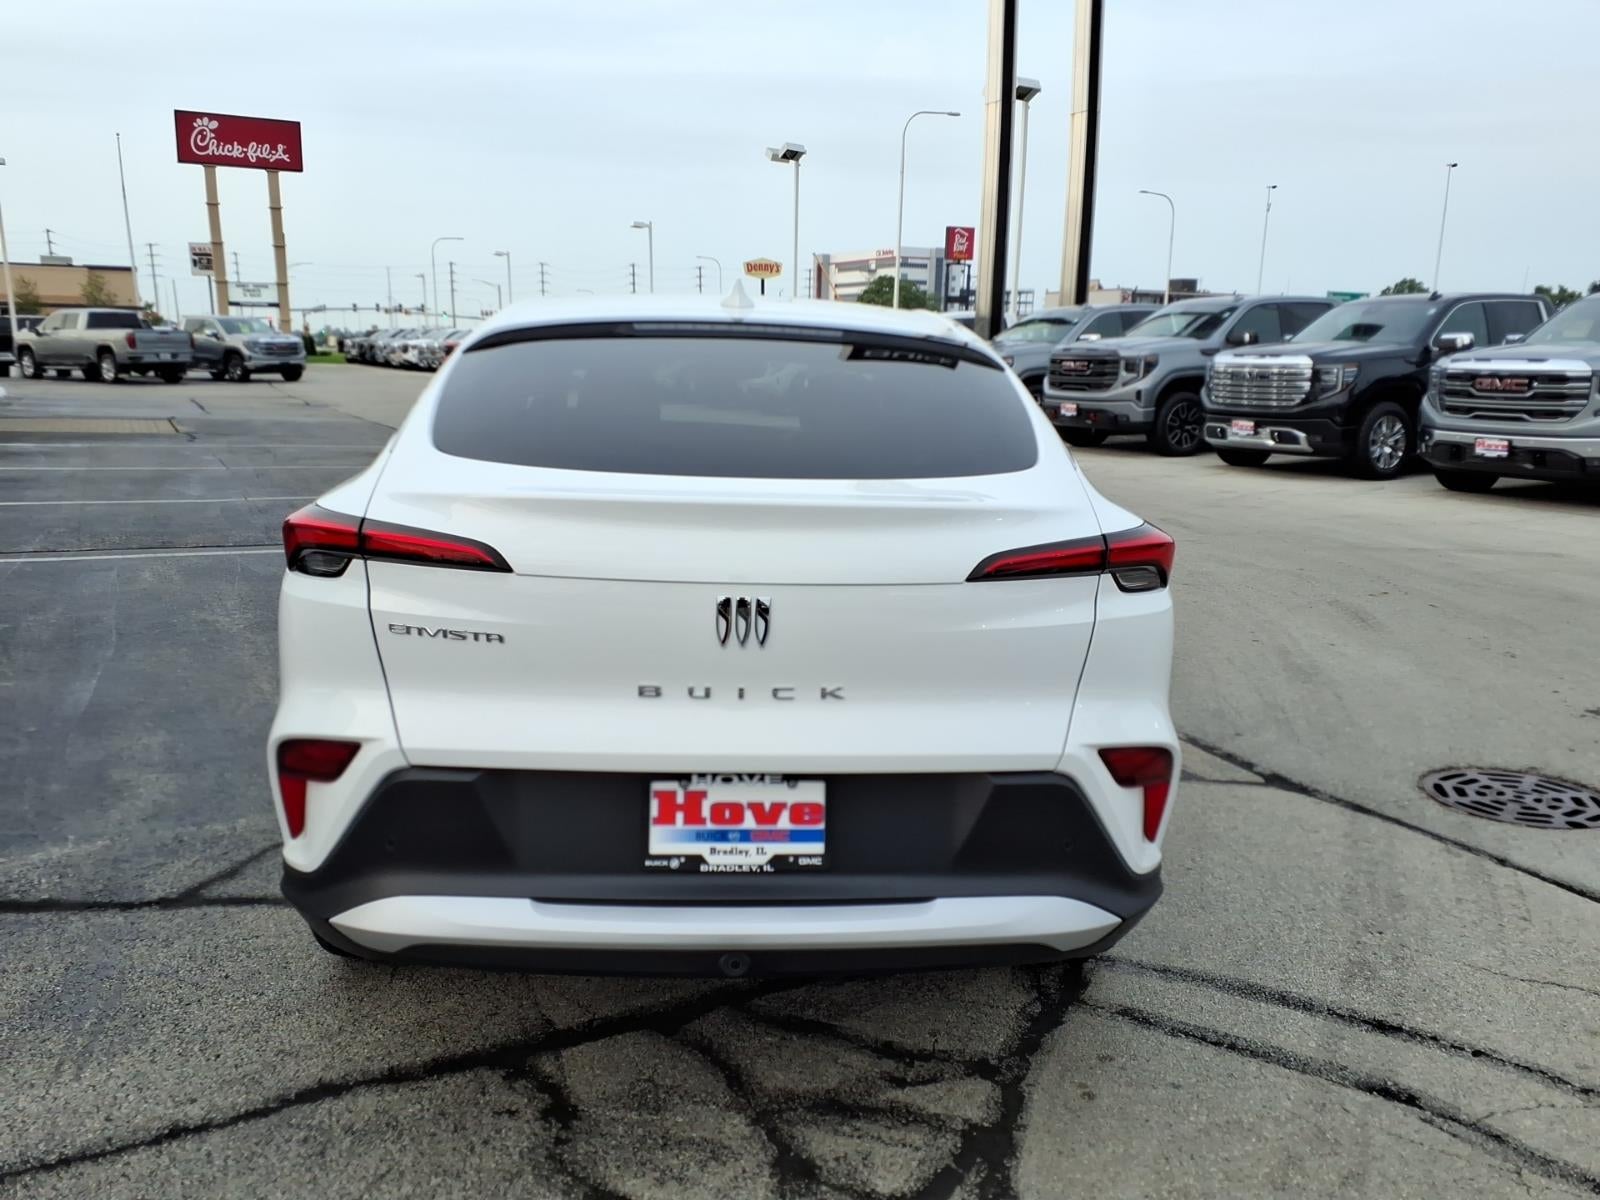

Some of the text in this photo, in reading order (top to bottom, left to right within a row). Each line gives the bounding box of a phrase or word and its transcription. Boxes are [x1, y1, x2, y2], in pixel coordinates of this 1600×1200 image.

[190, 120, 290, 163] Chick-fil-A
[745, 262, 782, 274] Denny's
[1473, 377, 1530, 392] GMC
[388, 622, 505, 644] ENVISTA
[637, 685, 846, 700] BUICK
[652, 789, 826, 826] Hove
[709, 846, 767, 858] Bradley, IL
[699, 864, 775, 874] BRADLEY, IL
[798, 857, 823, 866] GMC
